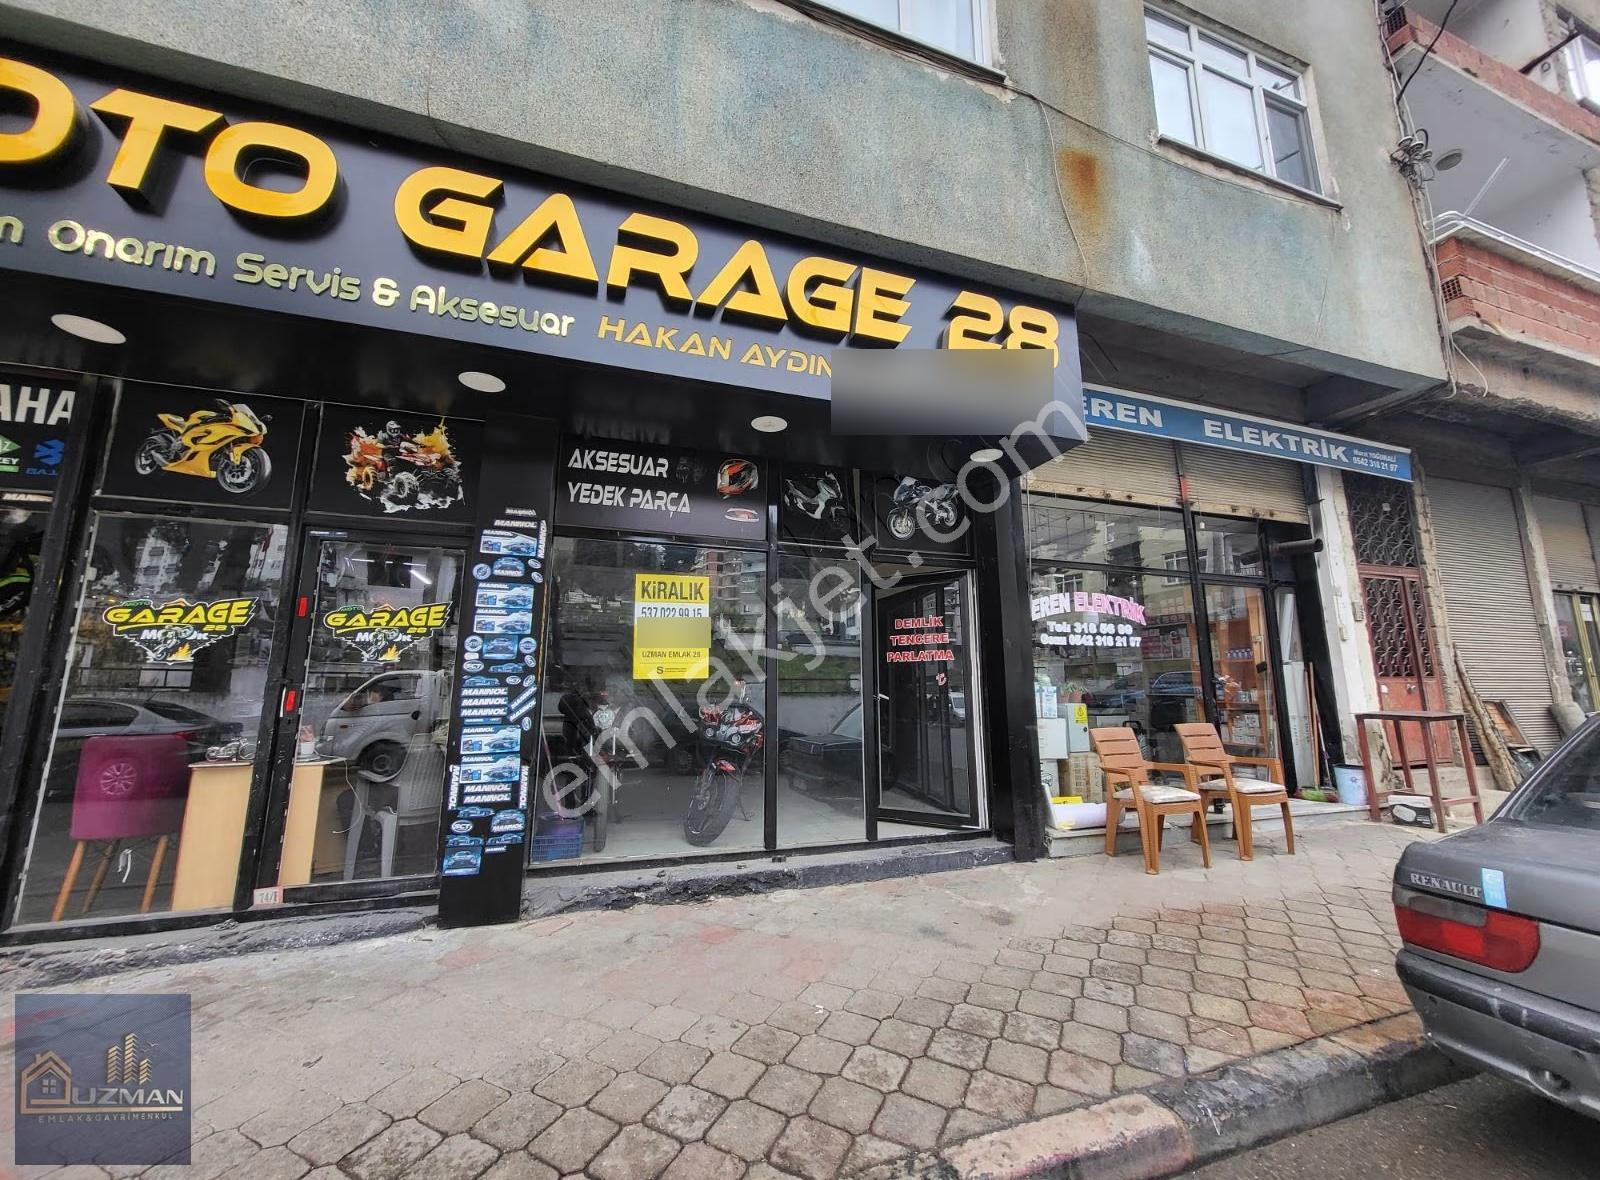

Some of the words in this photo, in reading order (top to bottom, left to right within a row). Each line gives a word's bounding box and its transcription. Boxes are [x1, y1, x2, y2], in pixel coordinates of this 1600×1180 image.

[394, 166, 915, 341] GARAGE
[948, 290, 1059, 368] 28
[233, 253, 361, 301] Servis
[372, 278, 399, 307] &
[410, 285, 575, 337] Aksesuar
[597, 314, 734, 362] HAKAN
[740, 342, 832, 378] AYDIN
[1083, 395, 1163, 428] REN
[568, 448, 669, 478] AKSESUAR
[567, 481, 628, 508] YEDEK
[629, 488, 691, 518] PARÇA
[494, 520, 537, 528] MANNOL
[106, 600, 252, 624] GARAGE
[1031, 592, 1071, 621] EREN
[326, 605, 447, 627] GARAGE
[895, 615, 944, 630] DEMLİK
[889, 633, 950, 646] TENCERE
[642, 650, 667, 658] UZMAN
[887, 649, 955, 663] PARLATMA
[461, 688, 508, 696] MANNOL
[461, 698, 508, 706] MANNOL
[461, 708, 507, 717] MANNOL
[464, 783, 512, 793] MANNOL
[463, 793, 512, 804] MANNOL
[1410, 872, 1482, 899] RENAULT
